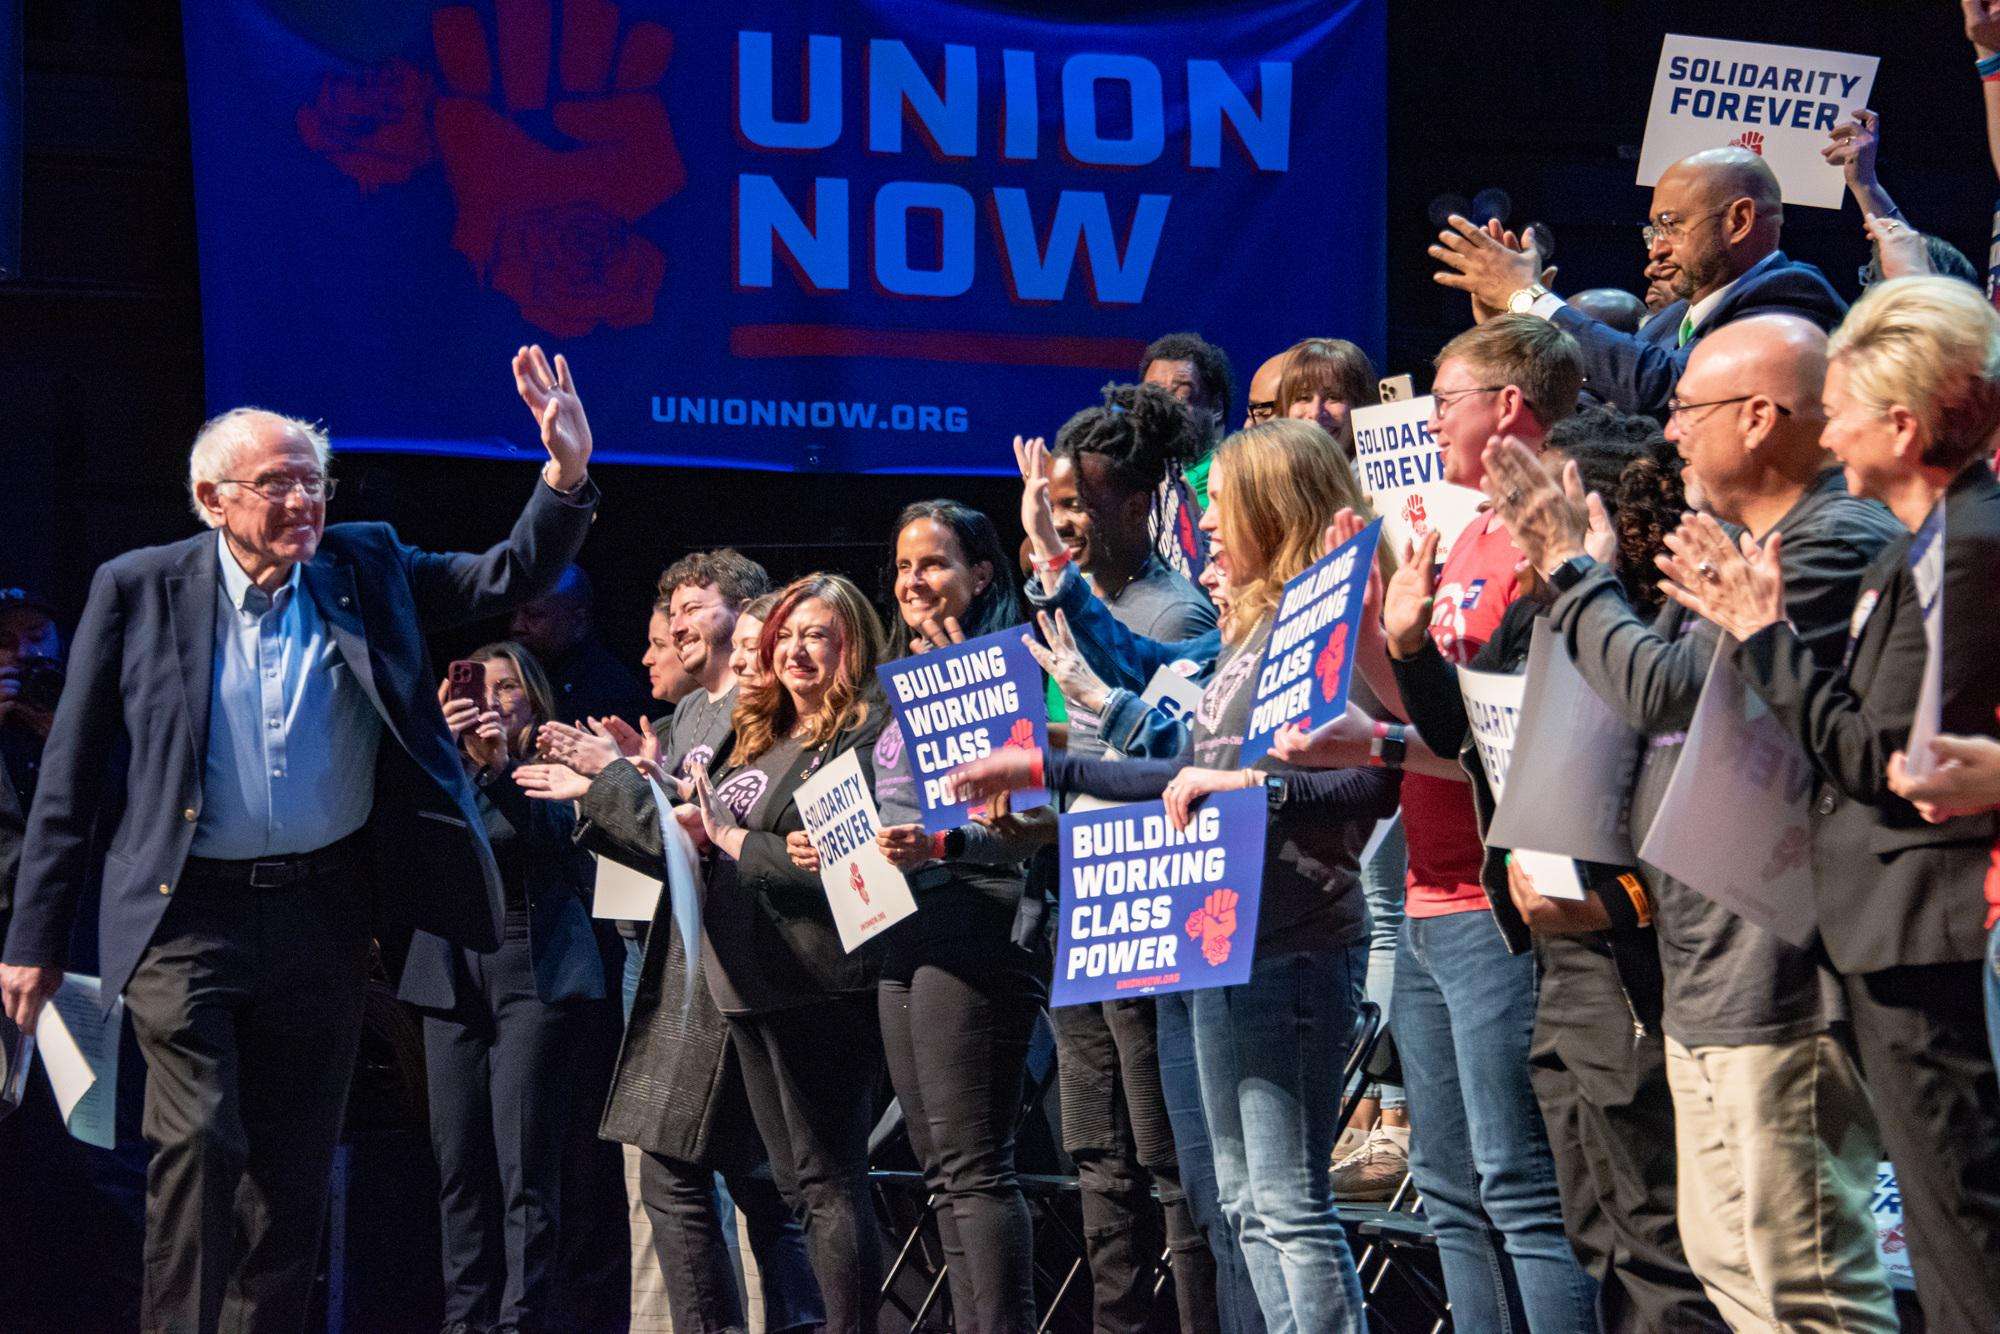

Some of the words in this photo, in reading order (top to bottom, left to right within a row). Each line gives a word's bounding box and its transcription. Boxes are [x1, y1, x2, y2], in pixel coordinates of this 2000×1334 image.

[734, 30, 1293, 172] UNION
[1669, 56, 1862, 98] SOLIDARITY
[1670, 87, 1840, 131] FOREVER
[733, 173, 1172, 304] NOW
[651, 396, 969, 432] UNIONNOW.ORG
[1356, 420, 1434, 456] SOLIDAR
[1278, 546, 1358, 622] BUILDING
[1268, 583, 1350, 660] WORKING
[892, 646, 1007, 703] BUILDING
[1256, 639, 1315, 700] CLASS
[905, 681, 1019, 738] WORKING
[1248, 677, 1312, 741] POWER
[915, 727, 992, 774] CLASS
[804, 773, 863, 835] SOLIDARITY
[816, 809, 876, 870] FOREVER
[1072, 807, 1220, 859] BUILDING
[1072, 847, 1226, 900] WORKING
[1071, 895, 1173, 940] CLASS
[1066, 935, 1178, 980] POWER
